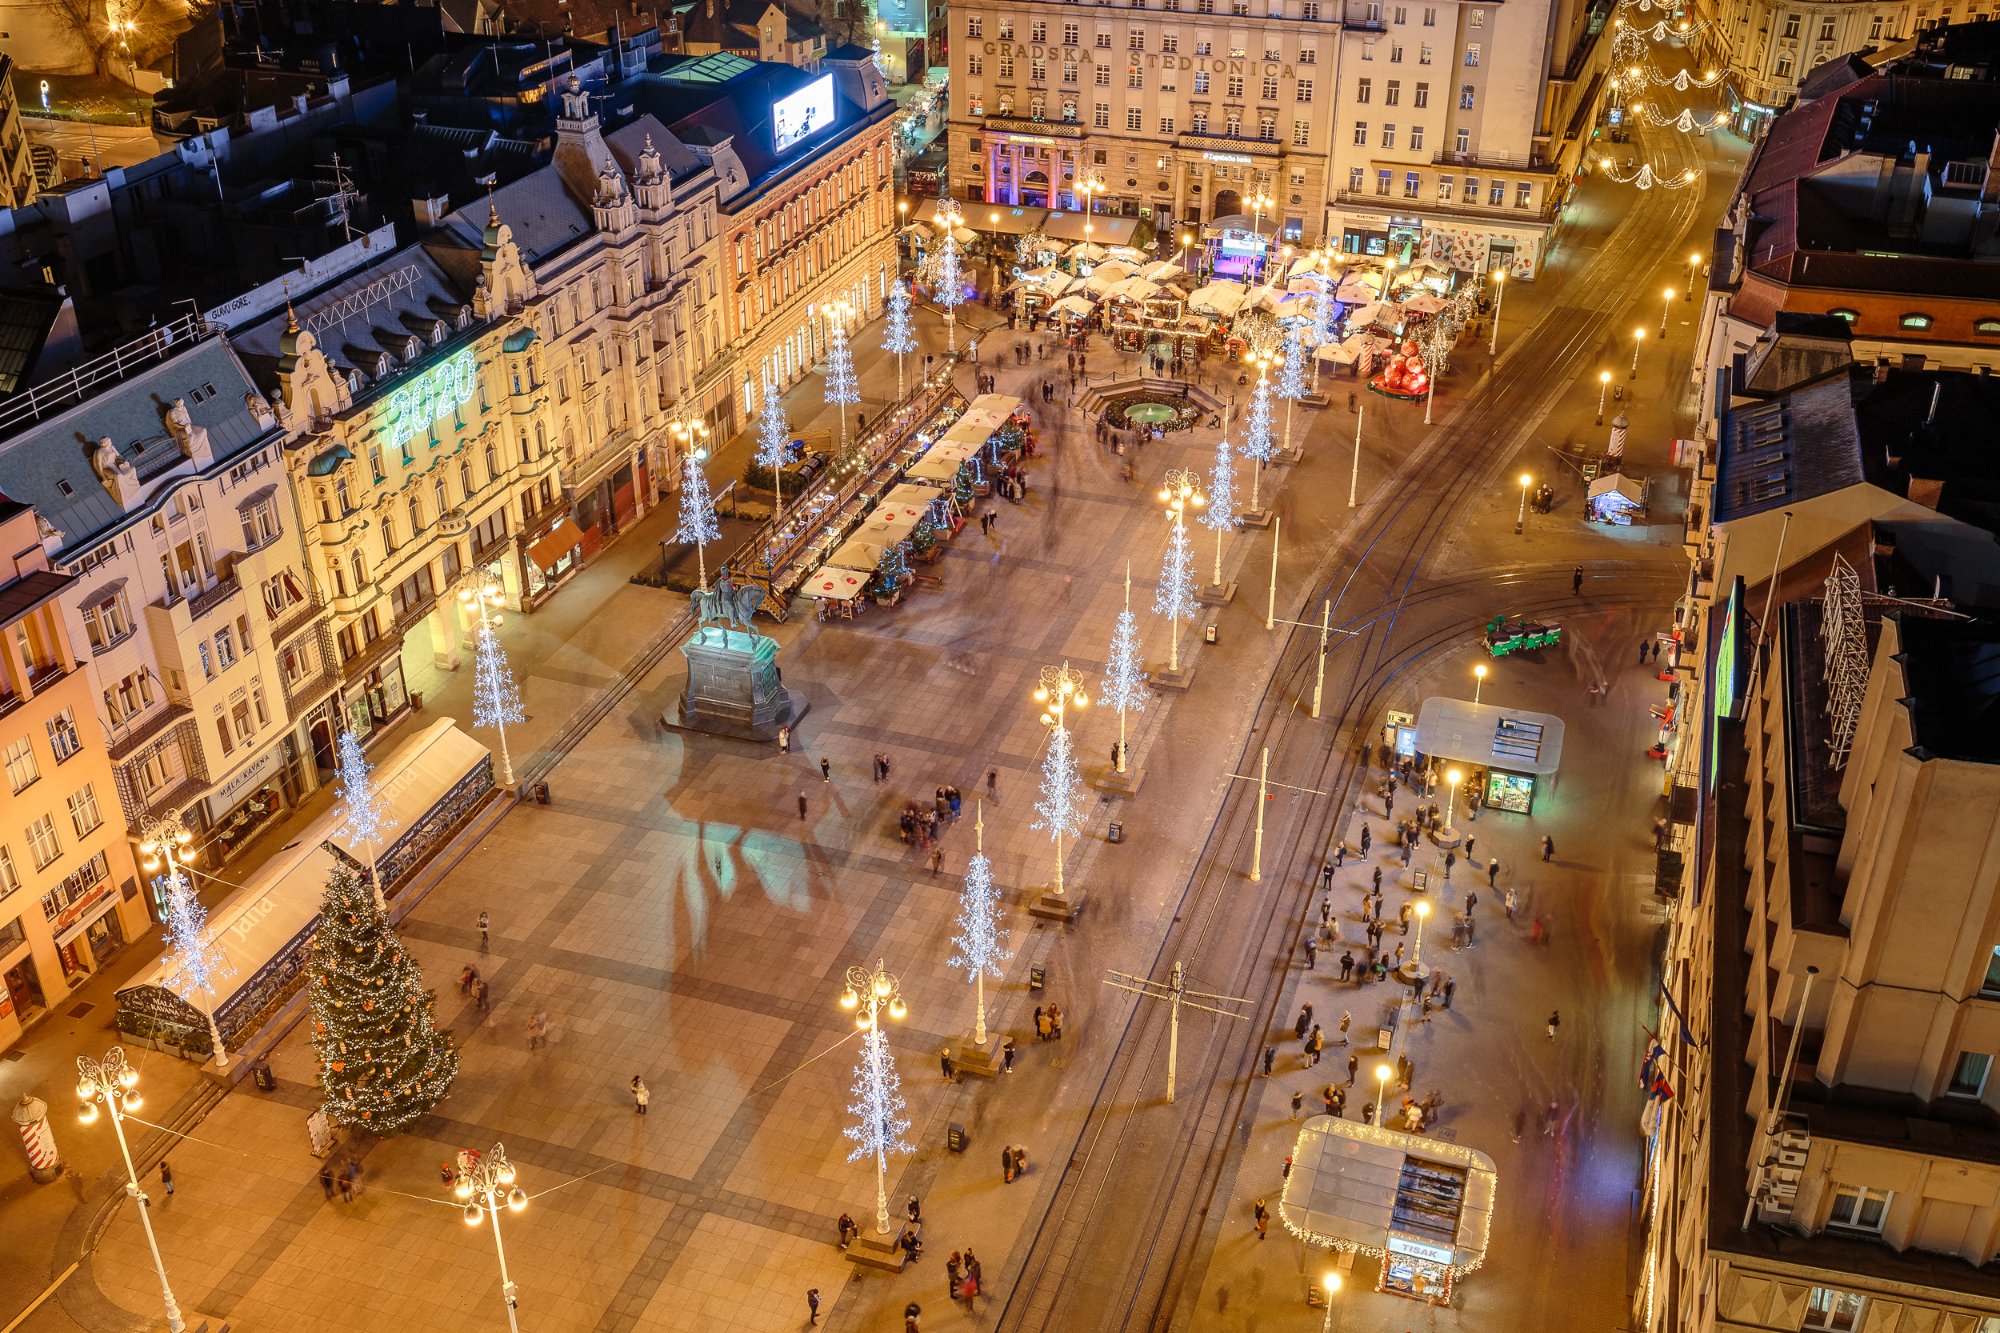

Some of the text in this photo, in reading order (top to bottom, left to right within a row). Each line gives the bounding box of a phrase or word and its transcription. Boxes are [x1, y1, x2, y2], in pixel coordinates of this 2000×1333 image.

[983, 42, 1093, 64] GRADSKA
[212, 304, 231, 319] GLAVU
[391, 351, 476, 449] 2020
[220, 755, 270, 798] MALA KAVANA
[150, 1004, 180, 1016] KAVANA
[152, 998, 174, 1008] MALA
[1402, 1243, 1438, 1258] TISAK
